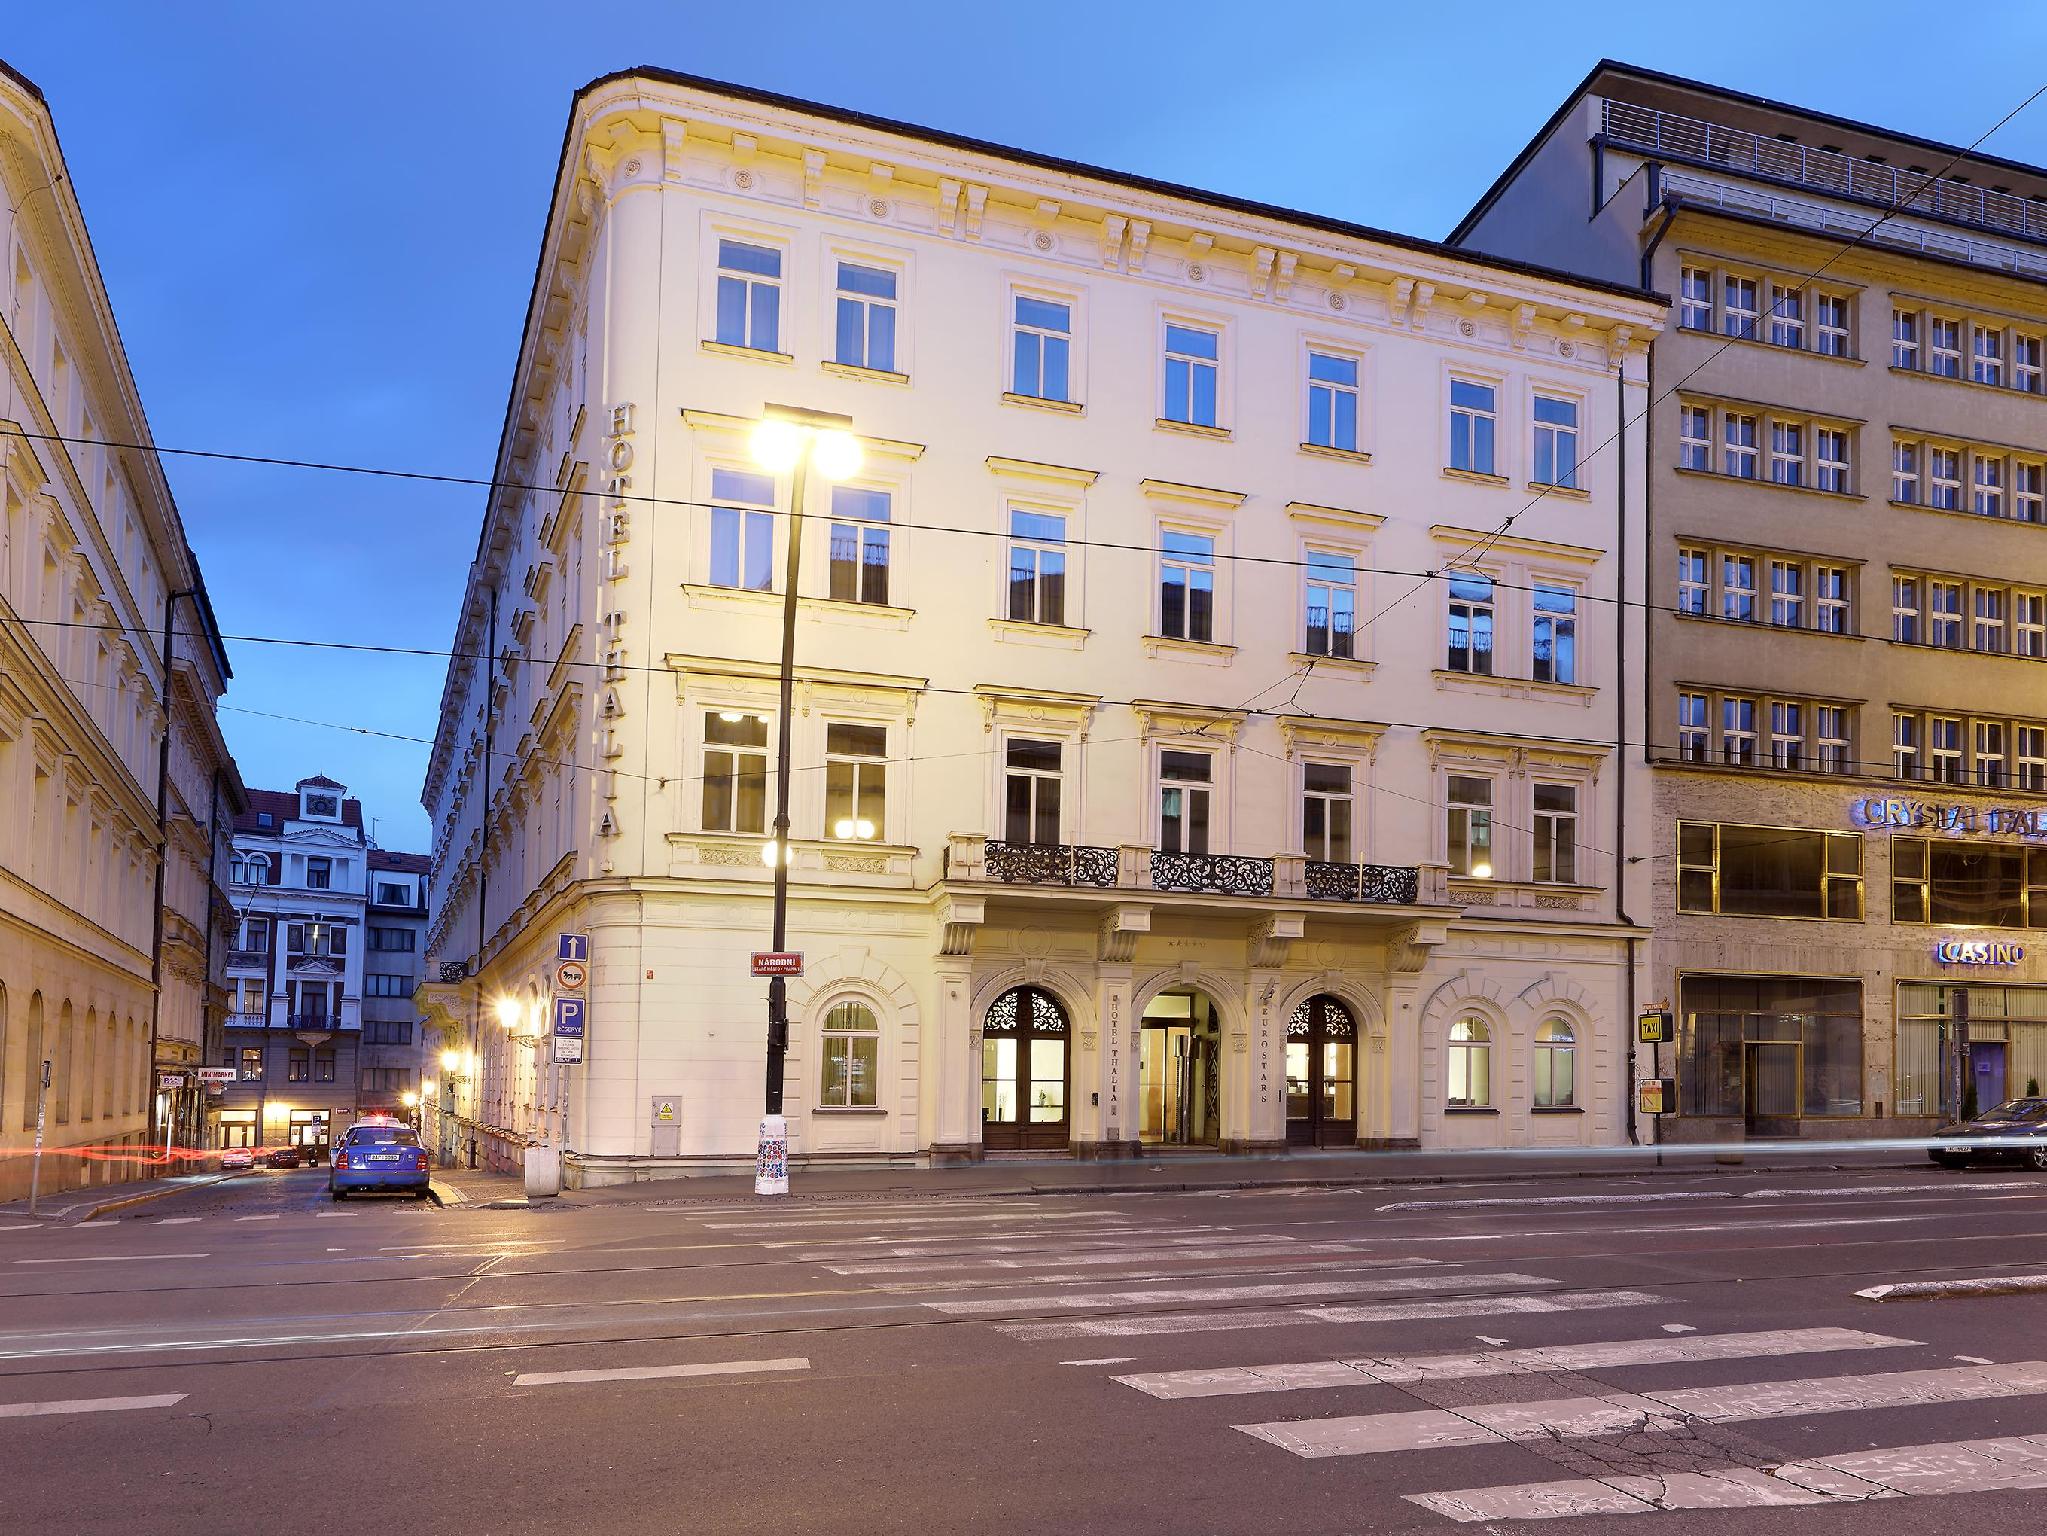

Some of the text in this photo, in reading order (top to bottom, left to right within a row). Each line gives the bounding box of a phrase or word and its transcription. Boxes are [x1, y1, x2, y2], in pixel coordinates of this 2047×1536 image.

[598, 403, 636, 837] HOTEL THALIA
[1864, 799, 1979, 831] CRYSTAL
[1942, 942, 2028, 964] CASINO
[561, 1003, 579, 1024] P
[1643, 1023, 1658, 1033] TAXI
